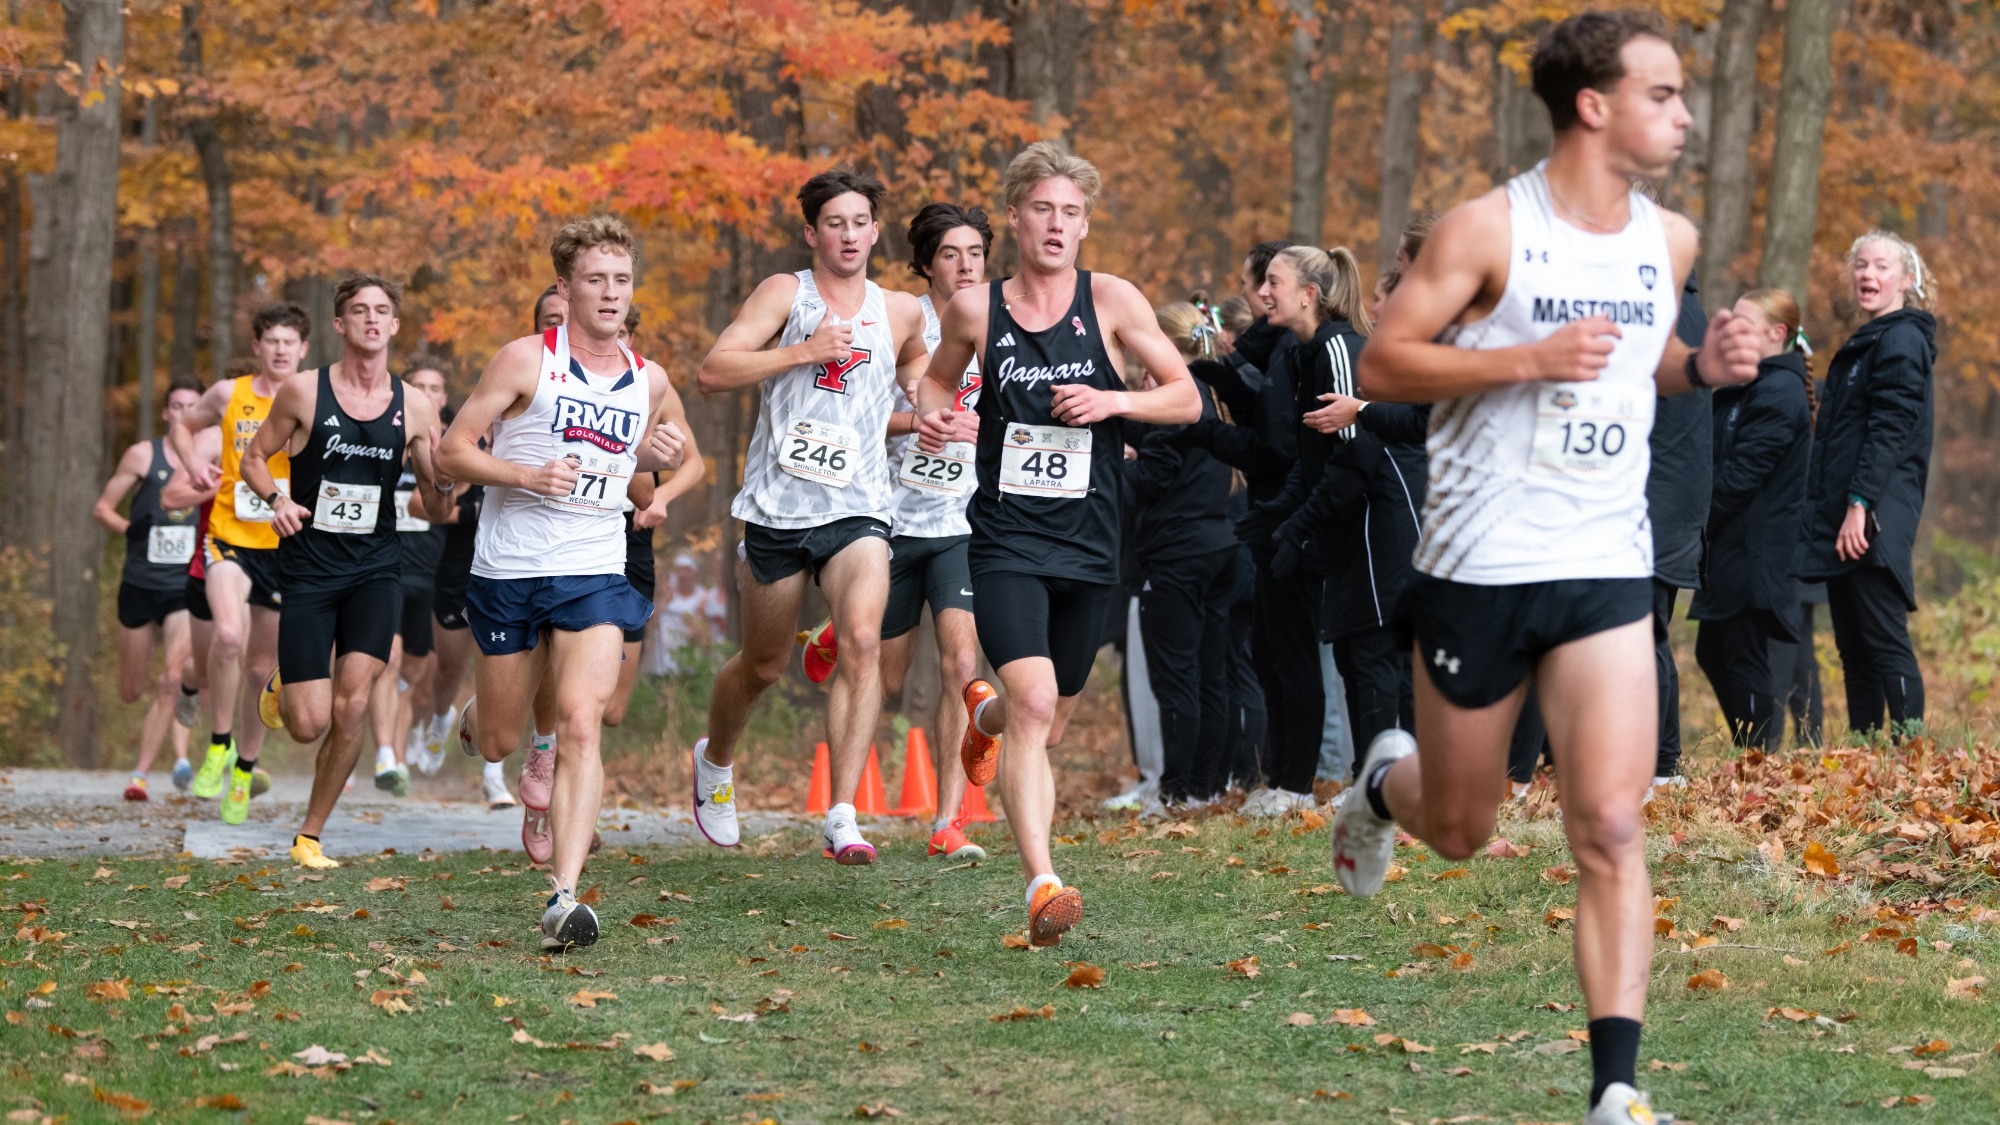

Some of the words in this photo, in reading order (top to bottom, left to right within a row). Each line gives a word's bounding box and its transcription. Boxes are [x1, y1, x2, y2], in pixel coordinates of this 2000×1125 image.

[805, 334, 872, 395] Y
[998, 356, 1096, 393] Jaguars
[552, 396, 640, 446] RMU
[323, 434, 394, 461] Jaguars
[568, 429, 623, 452] COLONIALS
[1561, 422, 1625, 456] 130
[789, 438, 847, 471] 246
[1021, 451, 1067, 479] 48
[793, 462, 837, 478] SHINGLETON
[910, 455, 963, 482] 229
[922, 478, 945, 488] FARRIS
[1024, 478, 1063, 488] LAPATRA
[330, 501, 363, 521] 43
[569, 496, 601, 507] WEDDING
